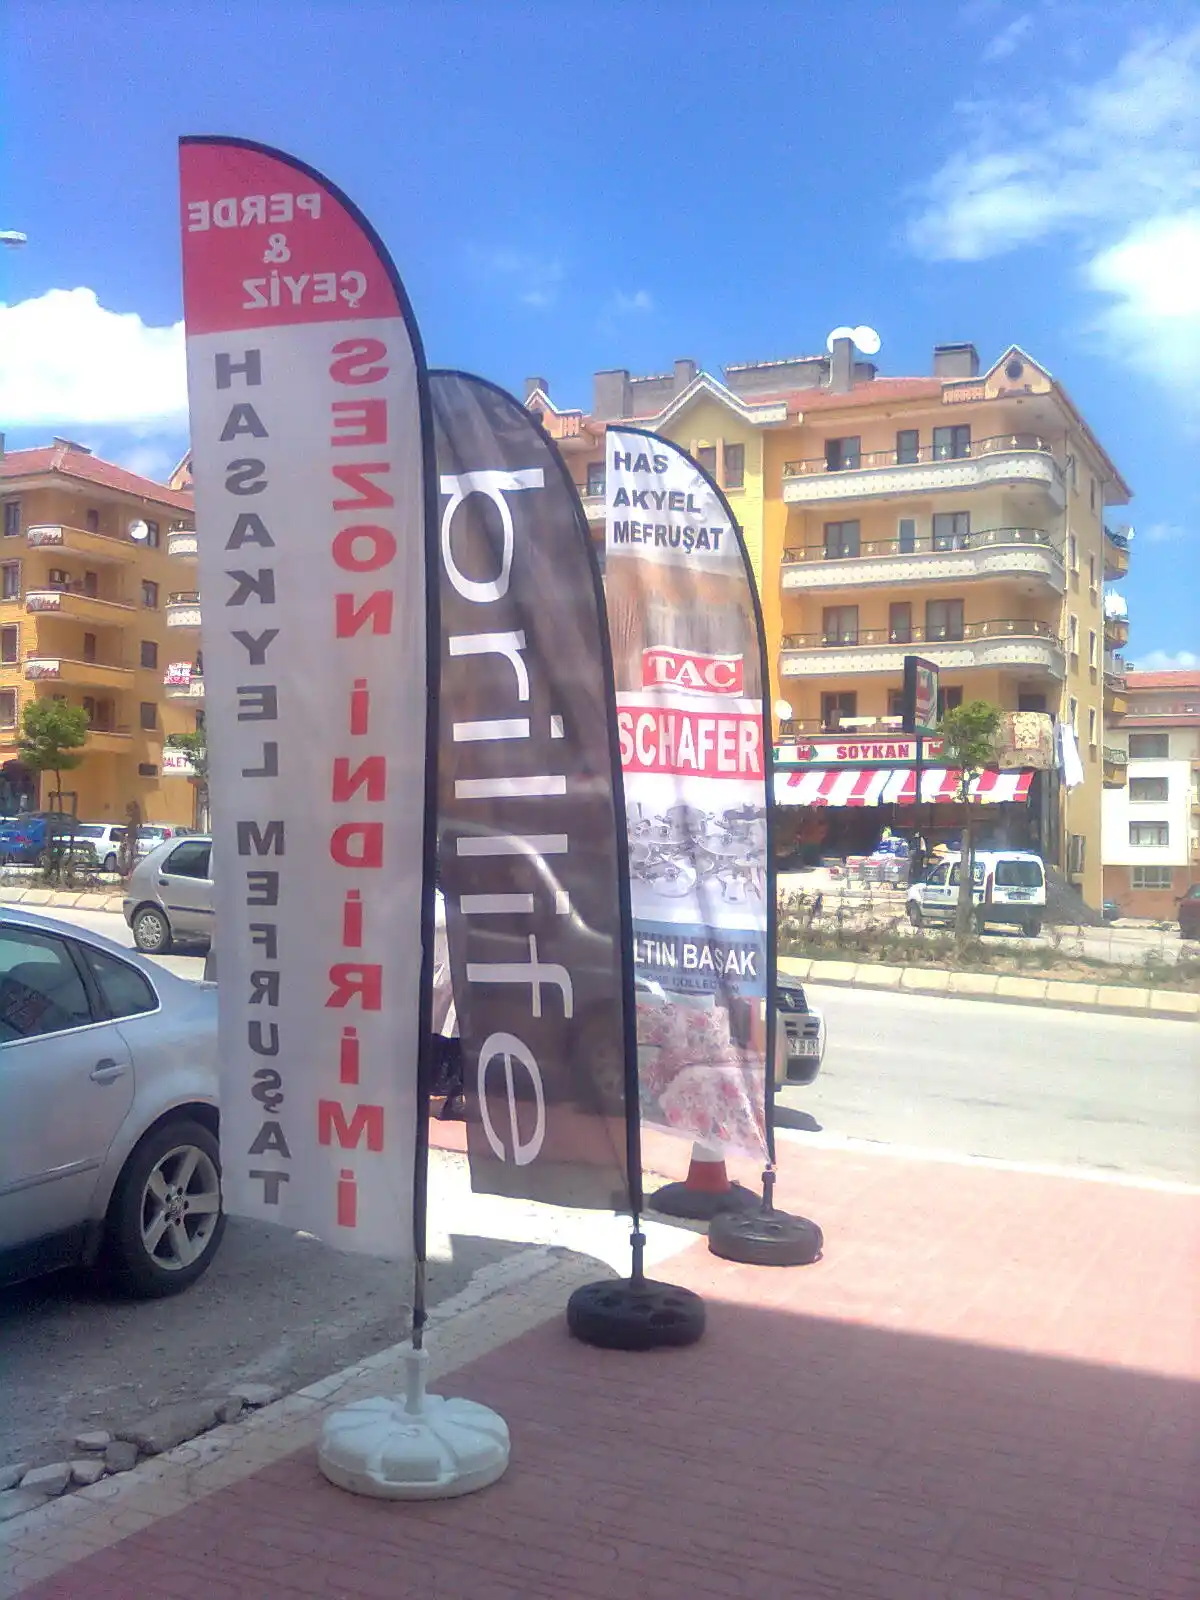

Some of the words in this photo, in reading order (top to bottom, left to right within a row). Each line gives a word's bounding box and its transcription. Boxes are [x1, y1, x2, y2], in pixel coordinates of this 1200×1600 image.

[613, 450, 669, 474] HAS
[612, 486, 702, 514] AKYEL
[612, 520, 724, 554] MEFRUŞAT
[618, 711, 761, 773] SCHAFER
[836, 744, 909, 760] SOYKAN
[439, 467, 574, 1166] brillife
[633, 938, 679, 969] LTIN
